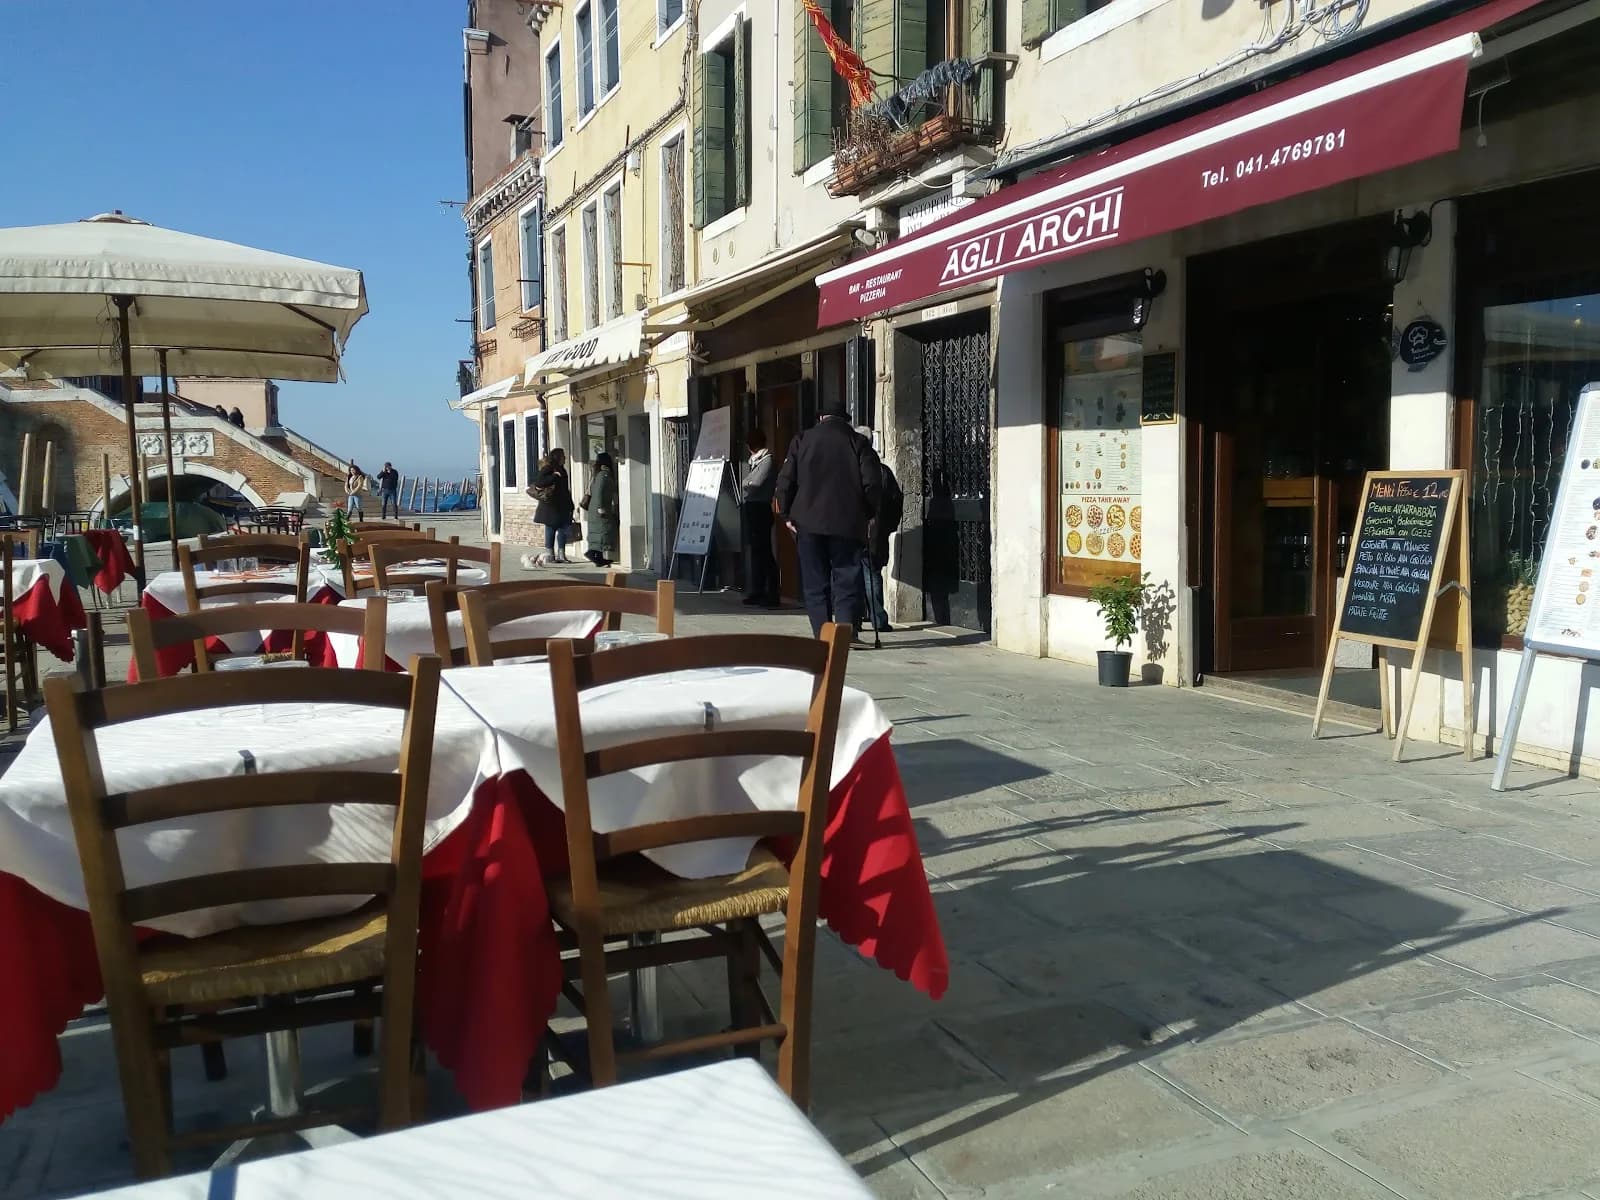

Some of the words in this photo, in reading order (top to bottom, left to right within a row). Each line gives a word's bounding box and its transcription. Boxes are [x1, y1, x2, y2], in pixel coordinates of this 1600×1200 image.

[1202, 167, 1229, 188] Tel.
[1236, 128, 1346, 178] 041.4769781
[940, 232, 1006, 280] AGLI
[1015, 192, 1123, 257] ARCHI
[848, 283, 861, 294] BAR
[865, 269, 903, 289] RESTAURANT
[859, 287, 886, 304] PIZZERIA
